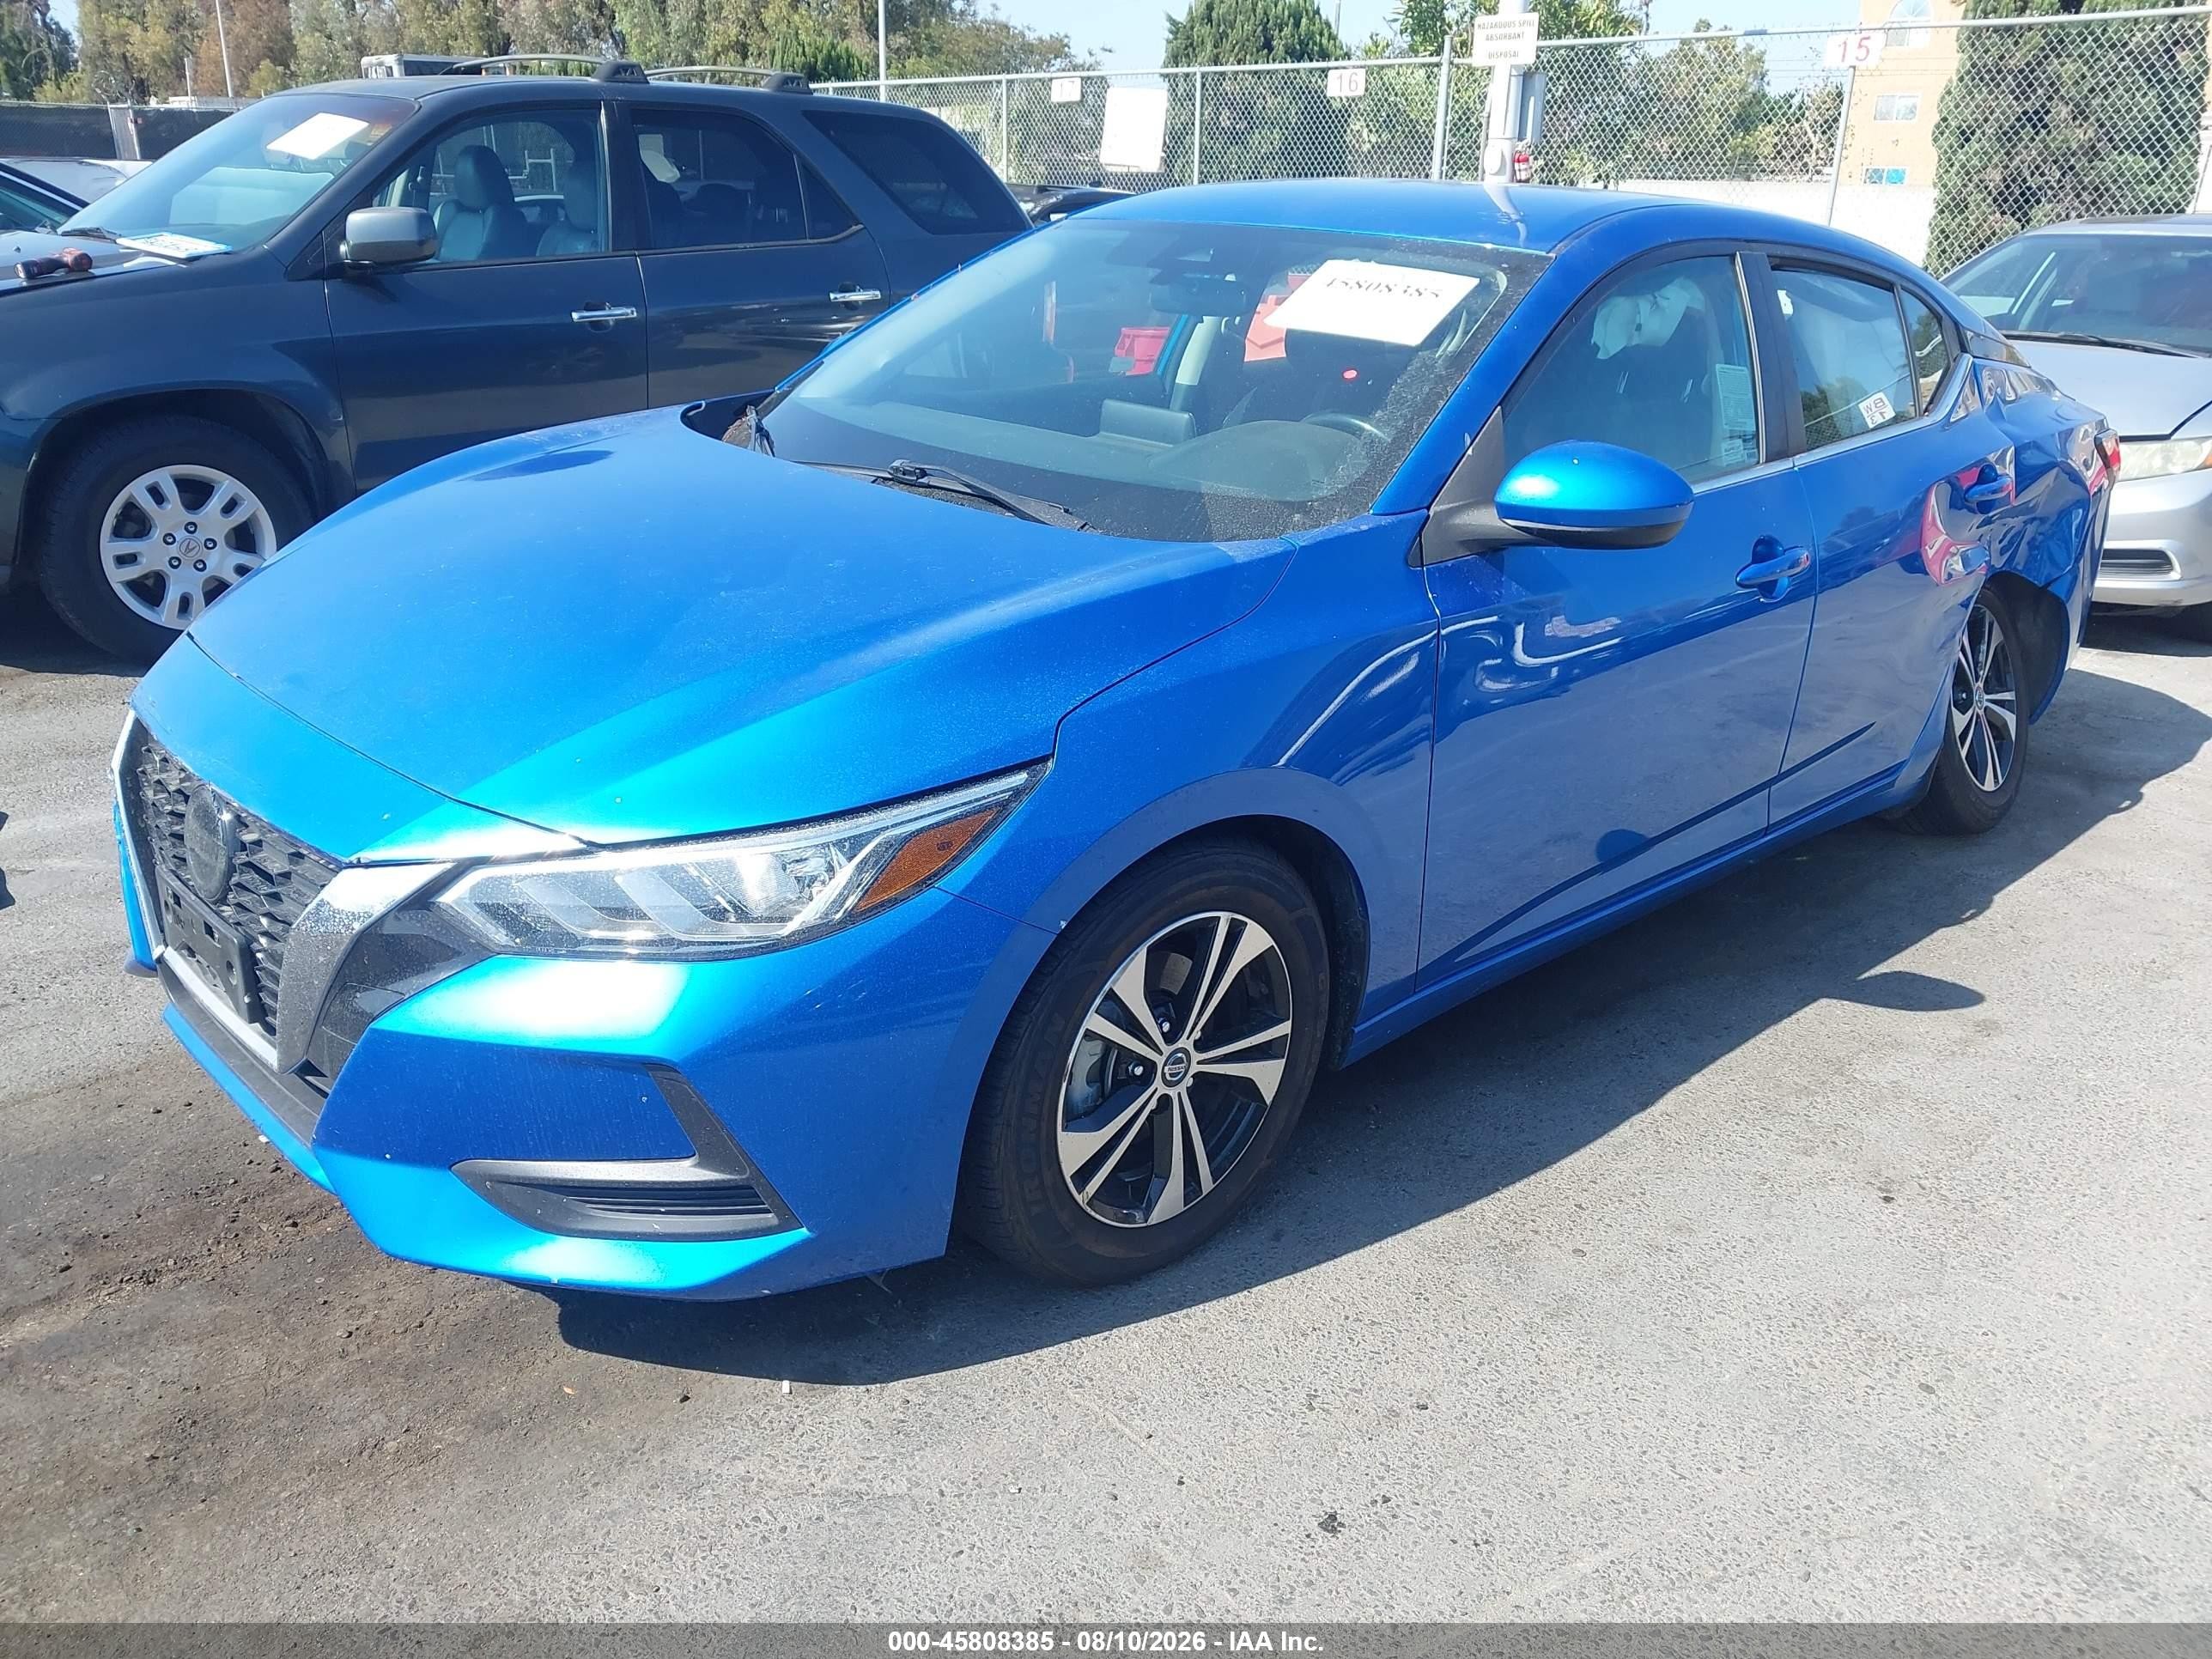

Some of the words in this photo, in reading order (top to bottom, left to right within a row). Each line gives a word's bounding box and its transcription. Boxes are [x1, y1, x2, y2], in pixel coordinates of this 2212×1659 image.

[1477, 20, 1516, 30] HAZARDOUS
[1839, 35, 1871, 63] 15
[1059, 80, 1075, 98] 17
[1336, 71, 1358, 93] 16
